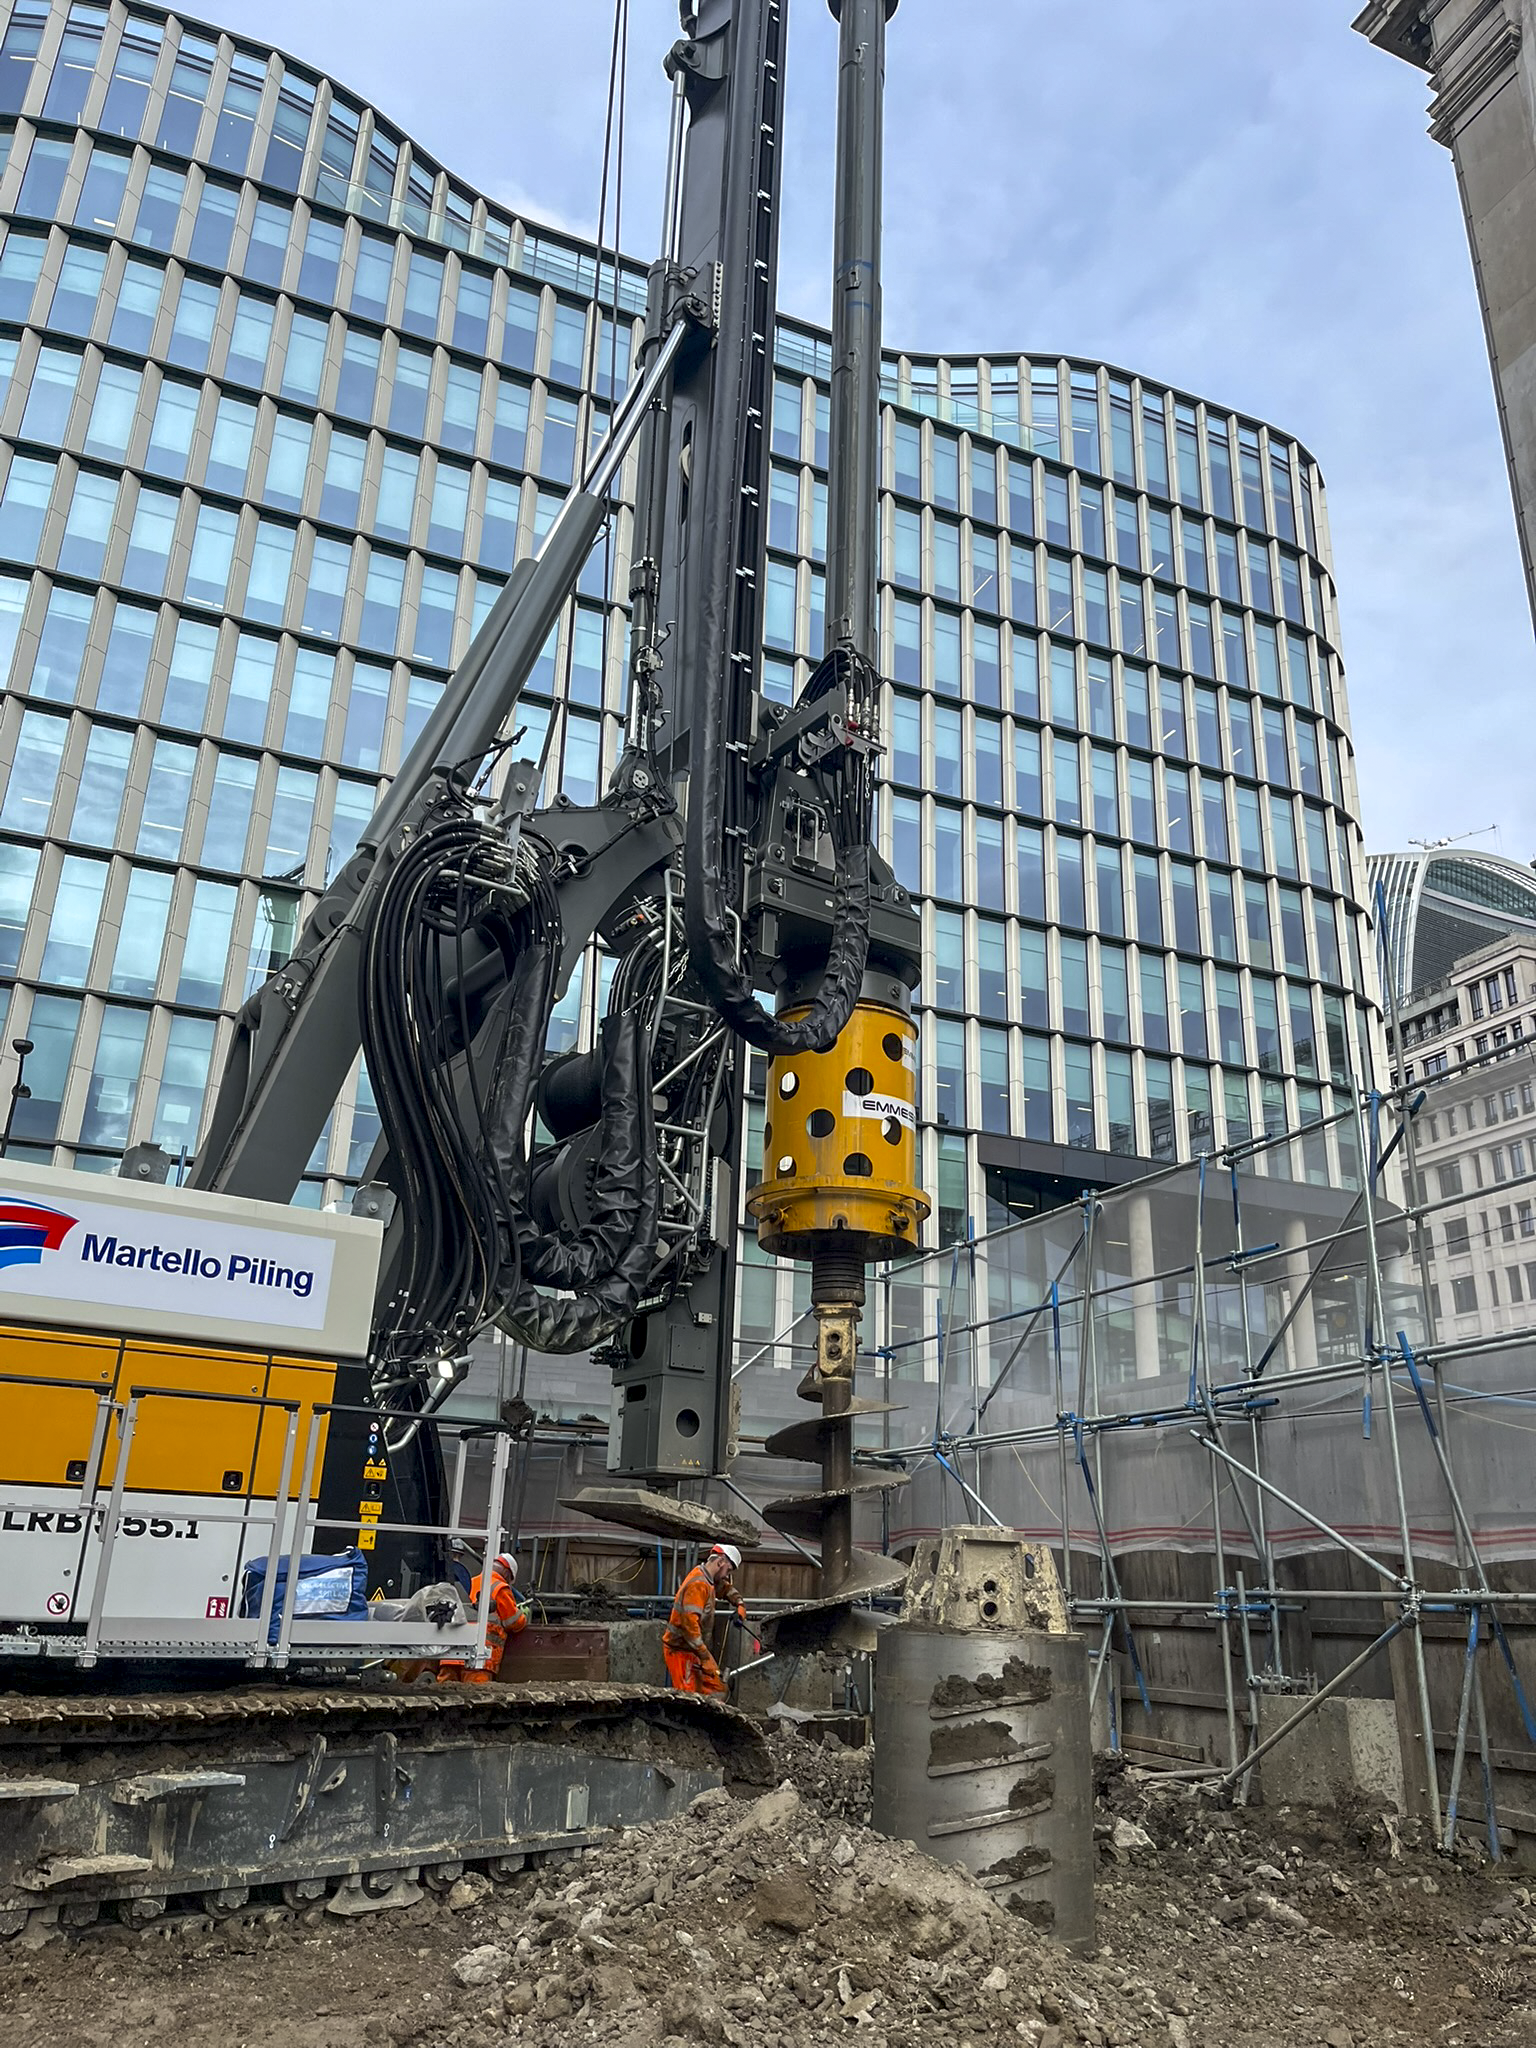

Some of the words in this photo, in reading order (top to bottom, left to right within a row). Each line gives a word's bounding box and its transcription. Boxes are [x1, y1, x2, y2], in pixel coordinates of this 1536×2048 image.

[862, 1100, 915, 1122] EMMES
[81, 1233, 221, 1279] Martello
[227, 1254, 314, 1297] Piling
[2, 1503, 83, 1533] LRB
